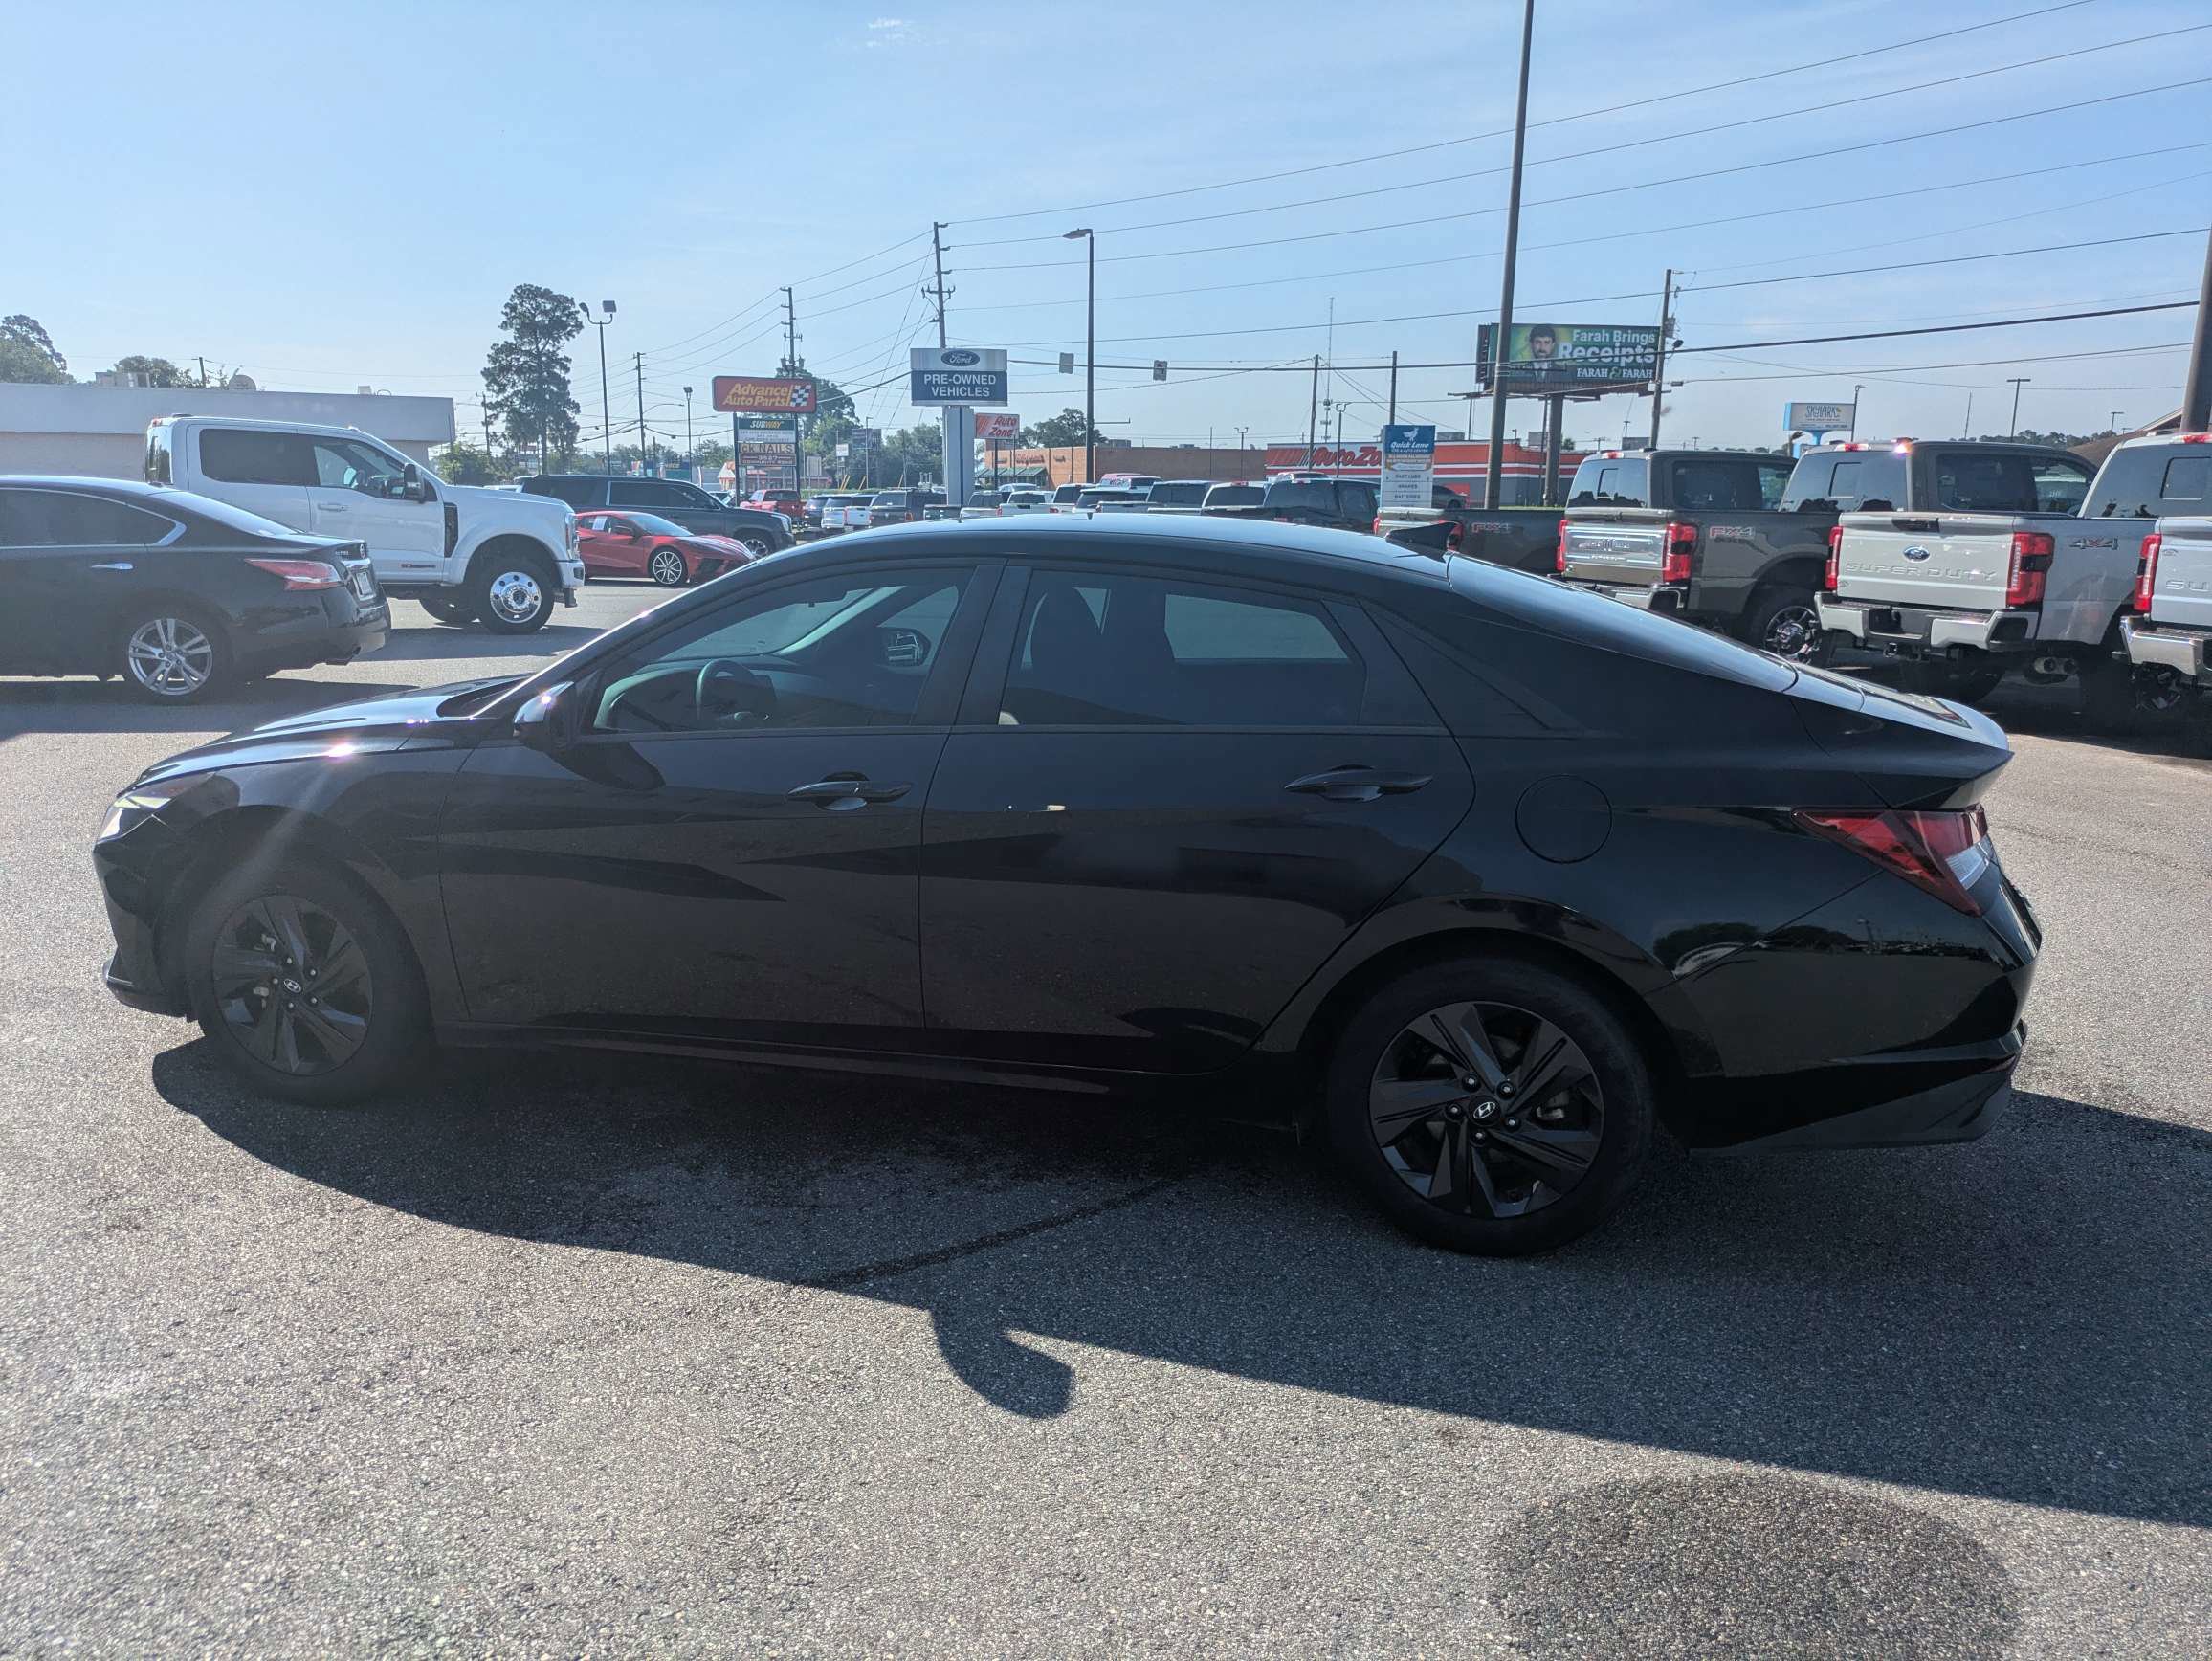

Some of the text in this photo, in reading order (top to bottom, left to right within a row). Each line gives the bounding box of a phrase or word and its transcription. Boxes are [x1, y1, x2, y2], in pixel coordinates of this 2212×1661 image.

[1572, 329, 1655, 344] Farah Brings
[949, 353, 973, 364] Ford
[1559, 342, 1655, 366] Receipts
[1576, 366, 1653, 379] FARAH & FARAH
[923, 374, 996, 385] PRE-OWNED
[729, 383, 789, 396] Advance
[931, 387, 990, 397] VEHICLES
[722, 395, 785, 407] Auto Parts
[750, 420, 782, 429] SUBWAY
[994, 416, 1017, 427] Auto
[988, 427, 1014, 437] Zone
[760, 443, 793, 454] NAILS
[1313, 446, 1382, 466] AutoZo
[1846, 563, 1997, 581] SUPER DUTY
